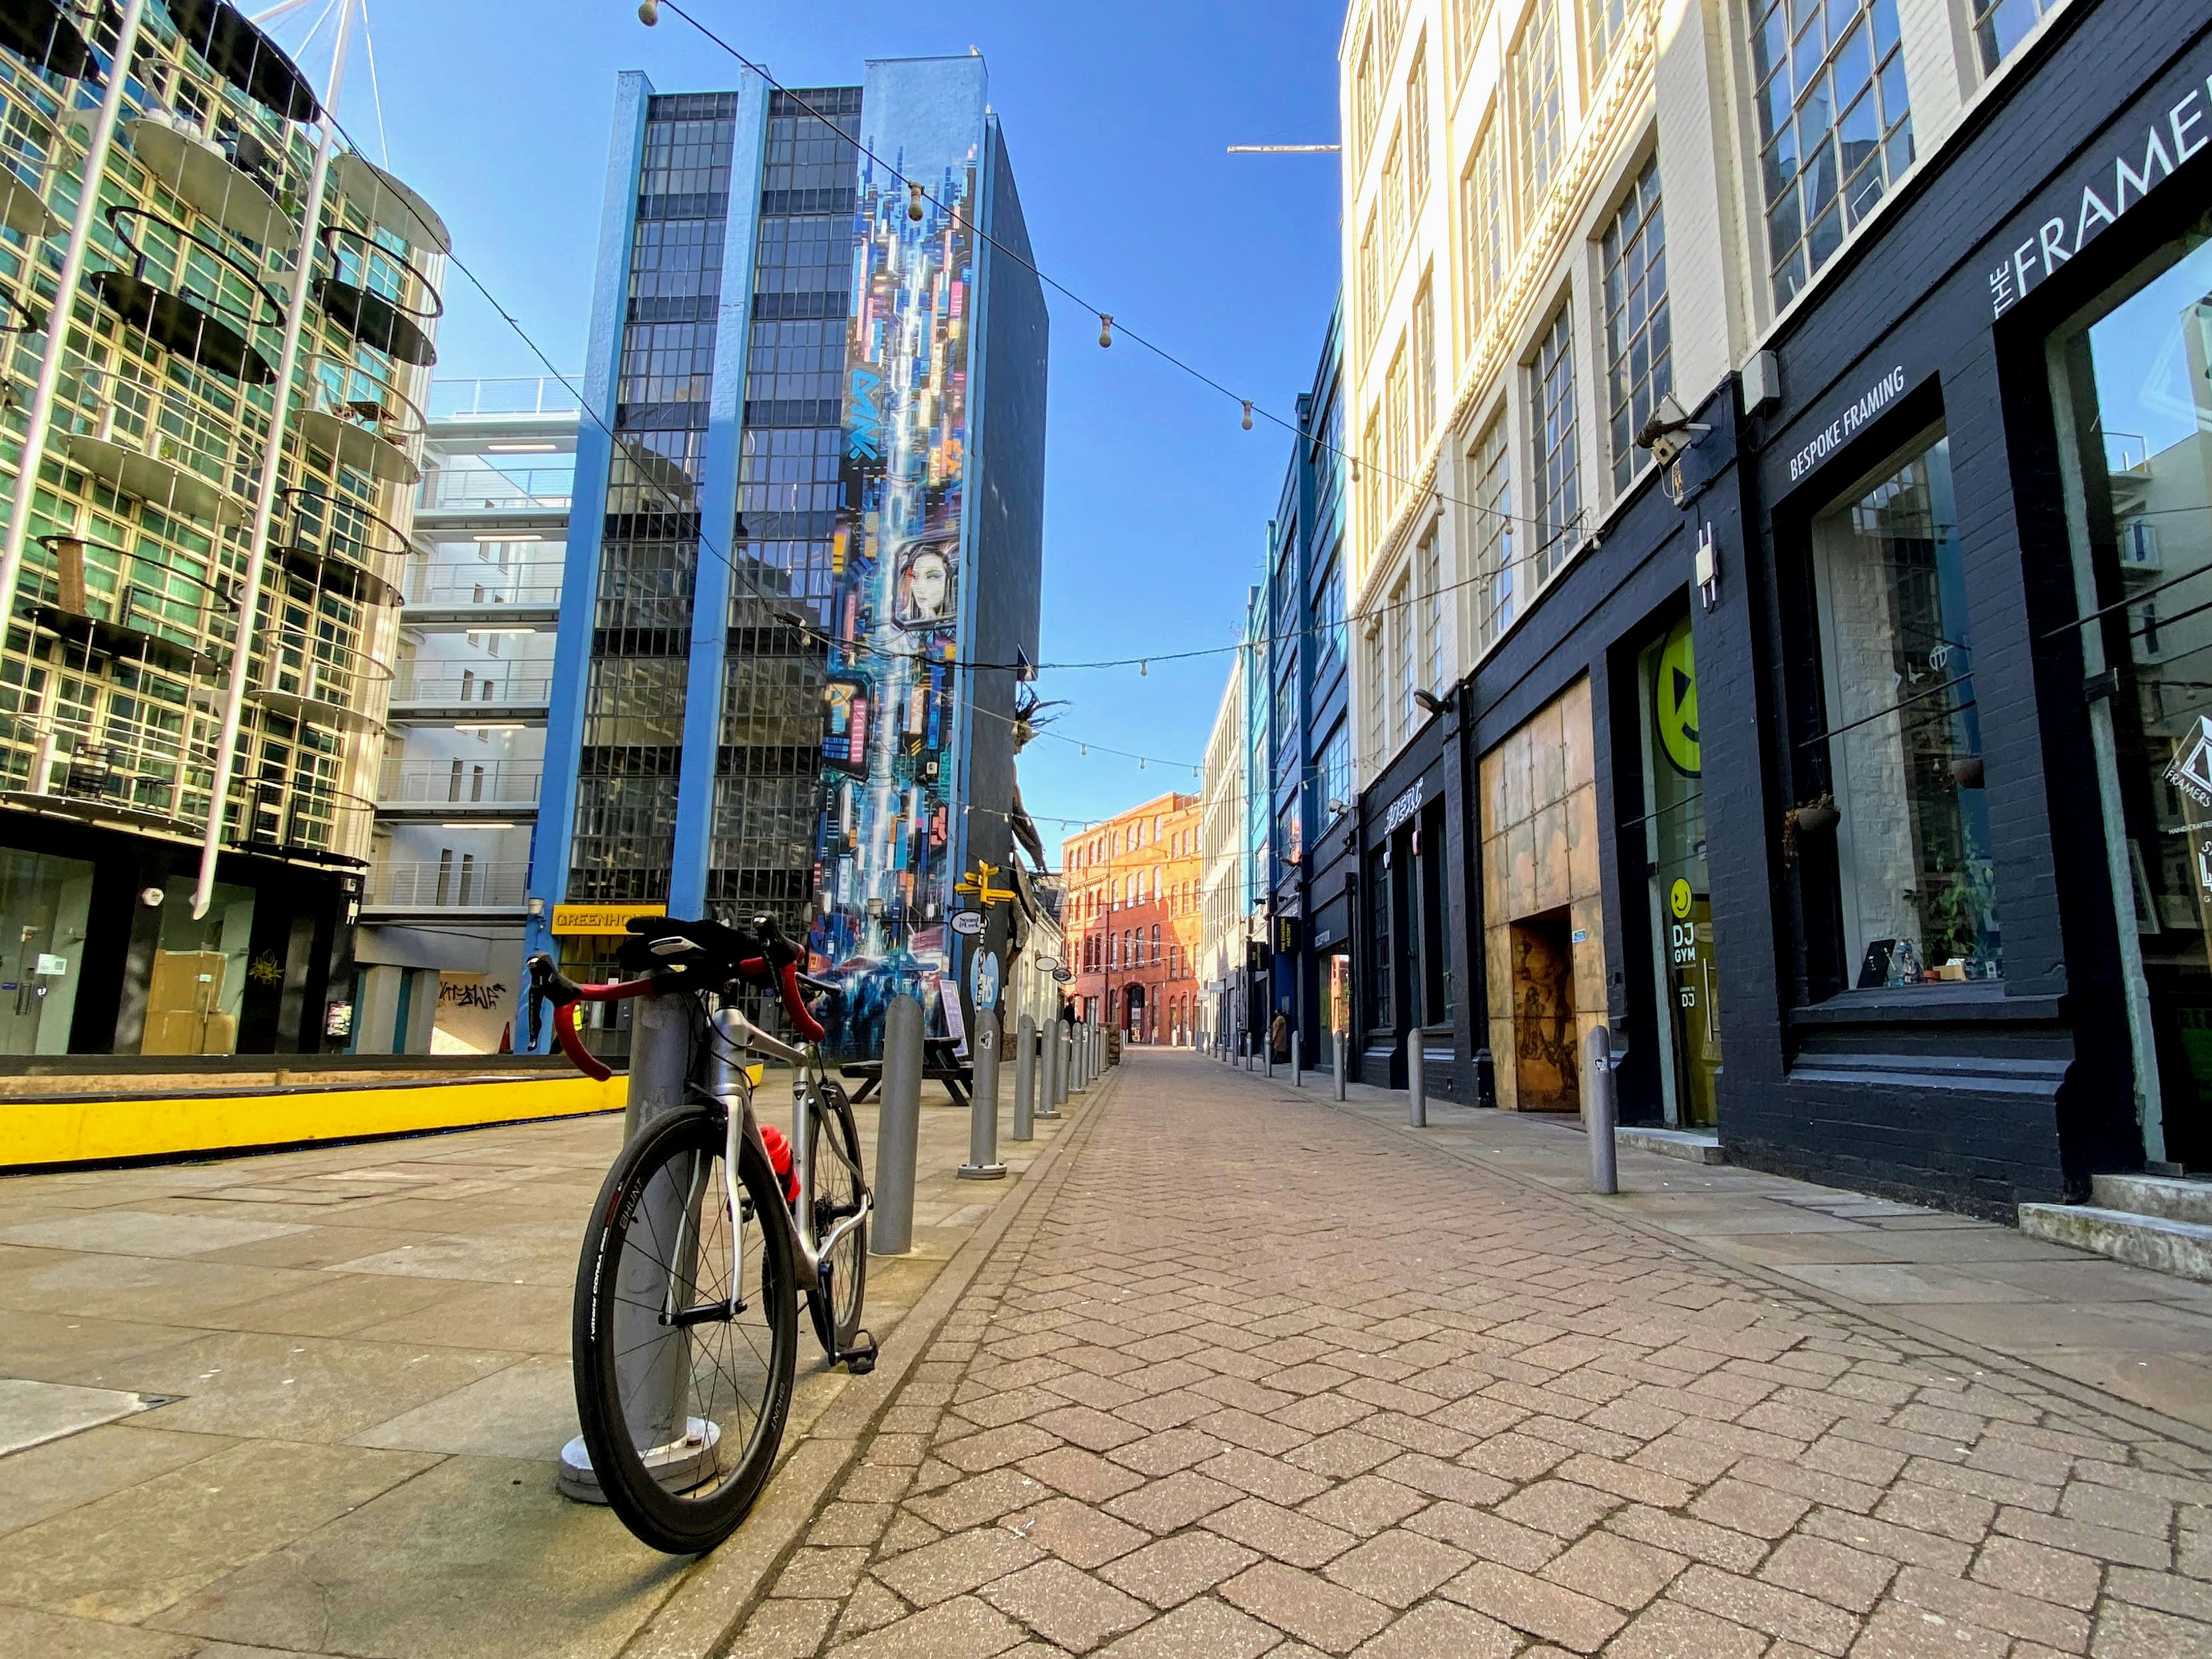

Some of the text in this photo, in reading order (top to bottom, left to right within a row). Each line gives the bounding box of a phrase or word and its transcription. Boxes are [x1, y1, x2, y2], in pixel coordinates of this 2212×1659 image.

[1990, 74, 2212, 320] THE FRAME
[1790, 365, 1904, 481] BESPOKE FRAMING
[2165, 770, 2211, 807] FRAMERS
[1673, 922, 1694, 947] DJ
[1674, 947, 1695, 963] GYM
[1681, 993, 1695, 1007] DJ
[624, 1176, 642, 1218] HUNT
[771, 1393, 783, 1432] HUNT
